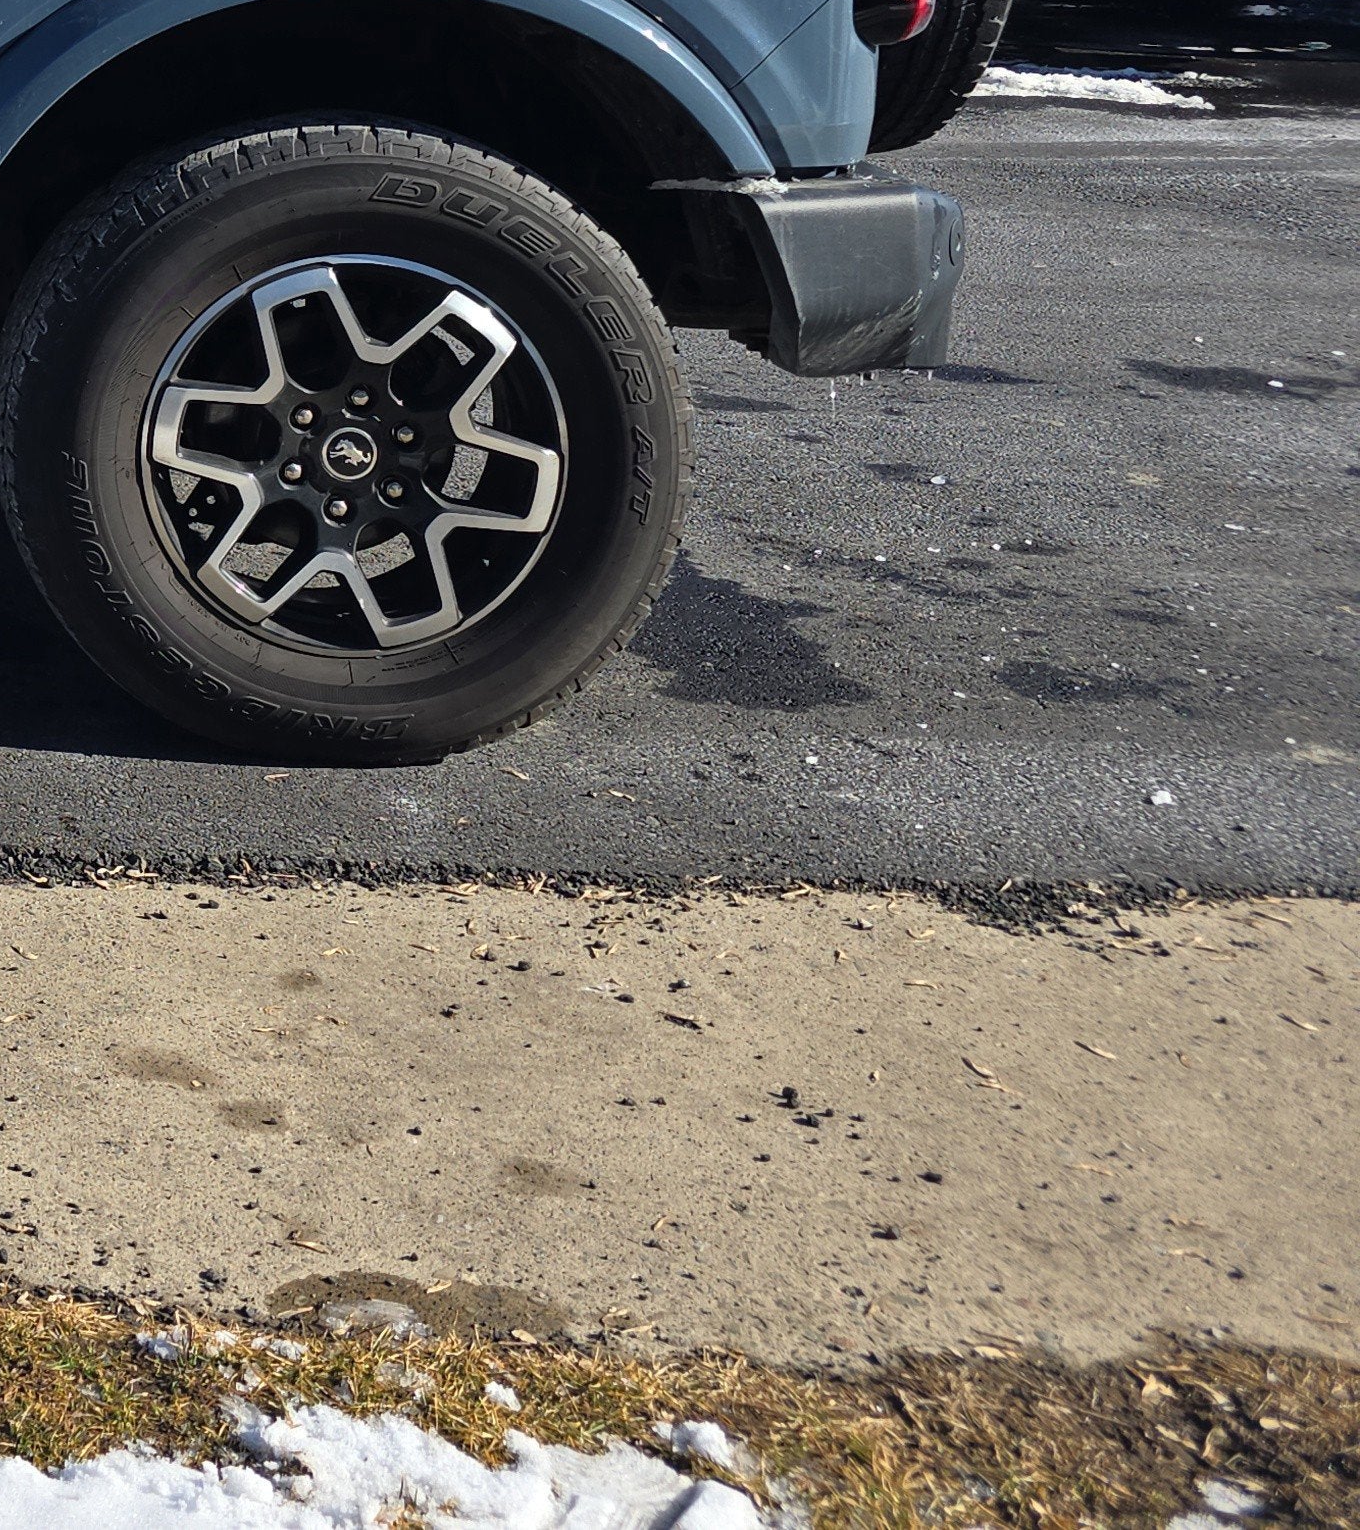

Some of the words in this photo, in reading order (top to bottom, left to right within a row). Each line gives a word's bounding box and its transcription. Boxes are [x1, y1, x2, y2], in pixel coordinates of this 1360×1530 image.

[368, 171, 656, 405] DUELER
[630, 424, 657, 526] A/T
[60, 448, 416, 743] BRIDGESTONE
